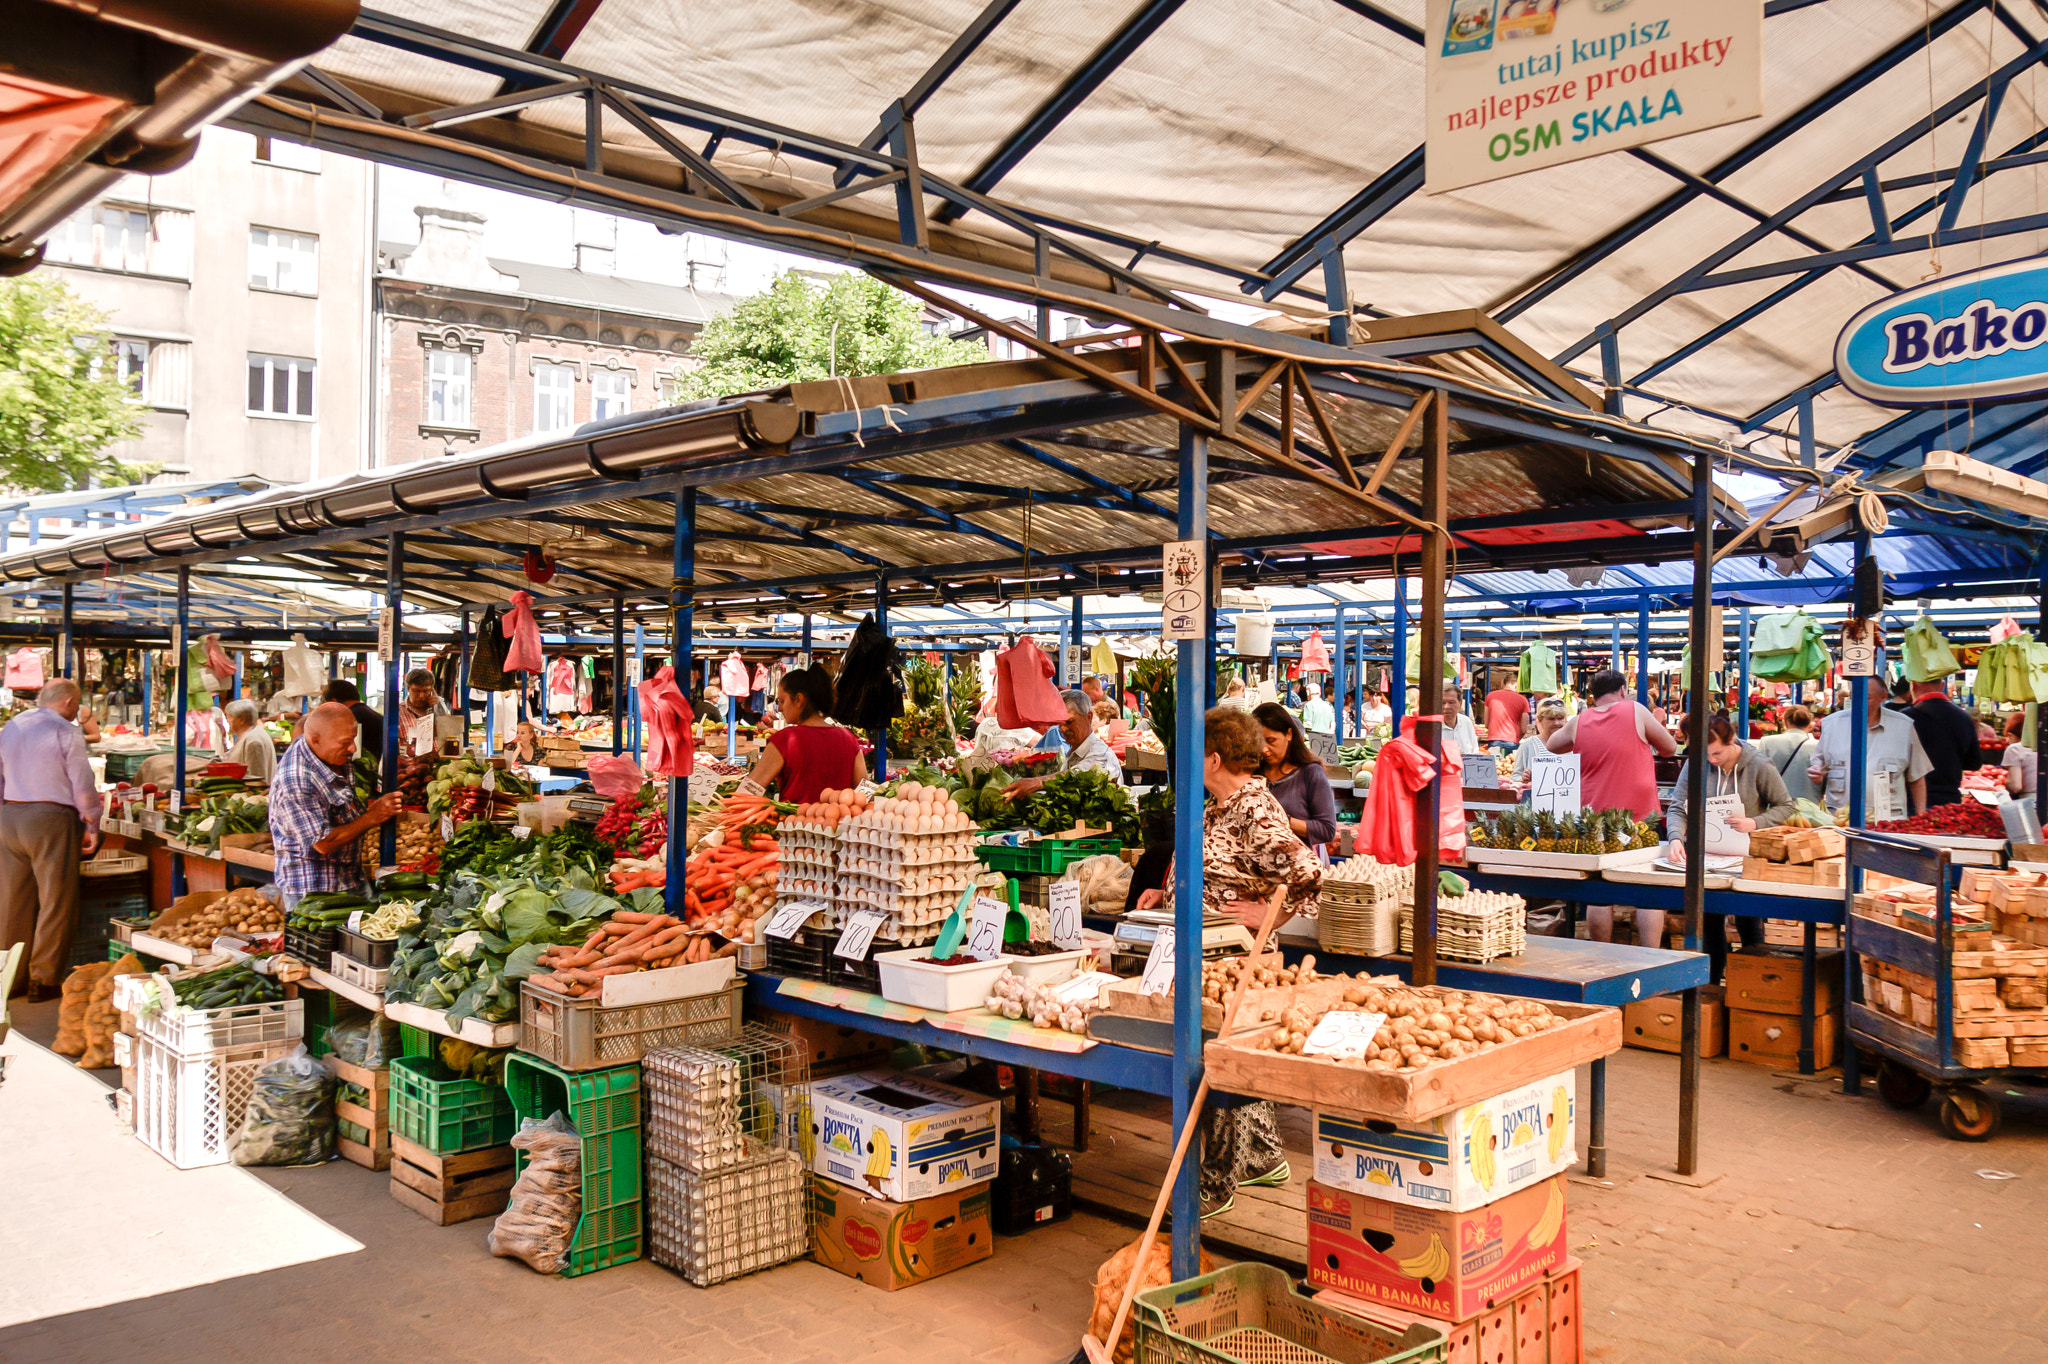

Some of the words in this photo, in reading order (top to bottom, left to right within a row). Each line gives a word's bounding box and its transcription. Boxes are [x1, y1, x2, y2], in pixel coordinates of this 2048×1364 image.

[1498, 44, 1561, 85] tutaj
[1572, 18, 1671, 65] kupisz
[1447, 80, 1577, 132] najlepsze
[1586, 36, 1733, 101] produkty
[1489, 119, 1561, 162] OSM
[1572, 88, 1683, 142] SKAŁA
[1891, 306, 2048, 366] Bako
[1180, 594, 1185, 608] 1
[1855, 650, 1861, 658] 3
[1052, 906, 1075, 943] 20
[823, 1116, 863, 1157] BONITA
[927, 1117, 957, 1132] PREMIUM
[958, 1114, 974, 1126] PACK
[1502, 1104, 1544, 1151] BONITA
[938, 1157, 970, 1185] BONITA
[1355, 1153, 1404, 1189] BONITA
[1308, 1186, 1352, 1215] Dole
[1462, 1210, 1503, 1254] Dole
[1462, 1258, 1483, 1275] CLASS
[1478, 1274, 1518, 1302] PREMIUM
[1519, 1251, 1556, 1280] BANANAS
[1313, 1267, 1377, 1297] PREMIUM
[1382, 1285, 1451, 1314] BANANAS
